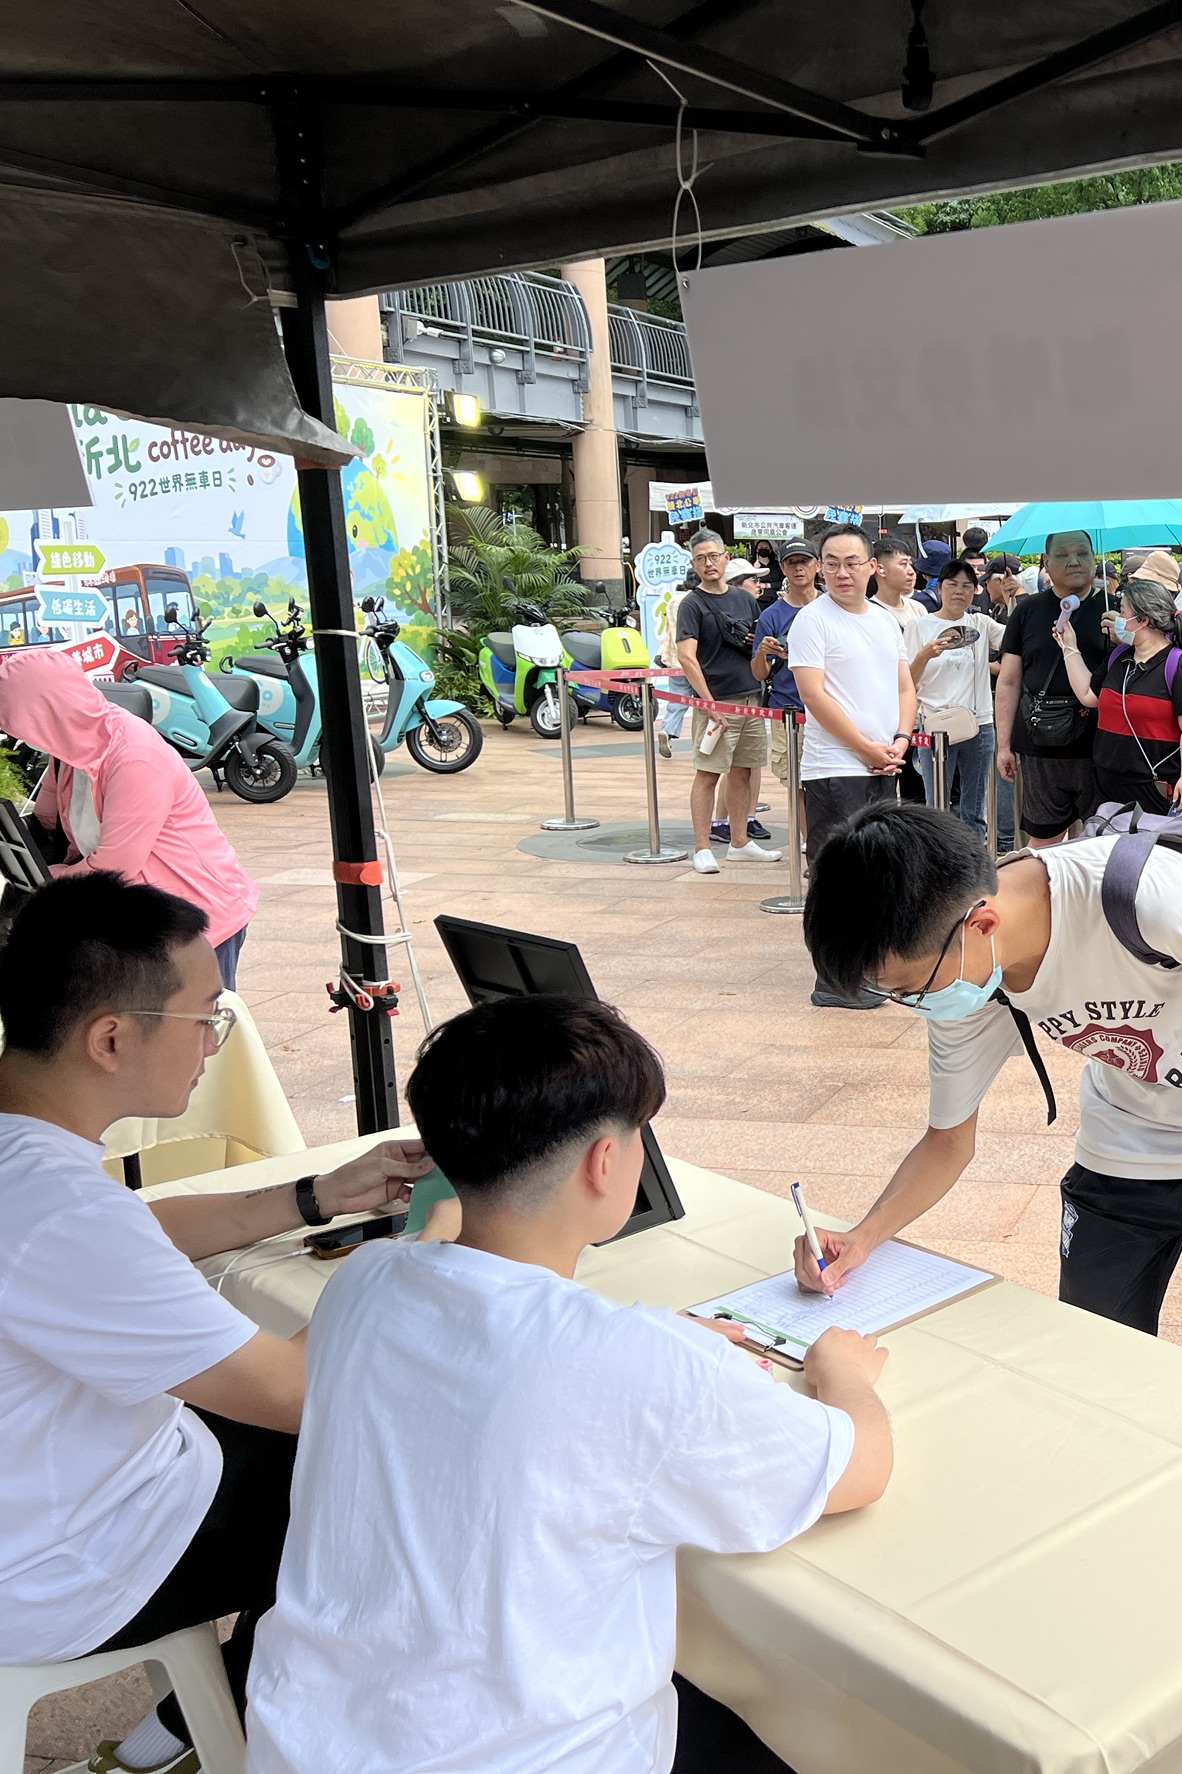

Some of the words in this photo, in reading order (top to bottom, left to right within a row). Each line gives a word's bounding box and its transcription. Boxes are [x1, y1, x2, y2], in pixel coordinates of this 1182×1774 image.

[148, 428, 214, 462] coffee
[129, 470, 222, 501] 922世界無車日
[50, 551, 95, 569] 綠色移動
[654, 555, 671, 565] 922
[647, 565, 686, 578] 世界無車日
[51, 598, 96, 616] 低碳生活
[680, 696, 717, 711] 新北市政府
[735, 705, 774, 718] 新北市政府
[1084, 1000, 1166, 1021] STYLE
[1099, 1035, 1137, 1048] COMPANY
